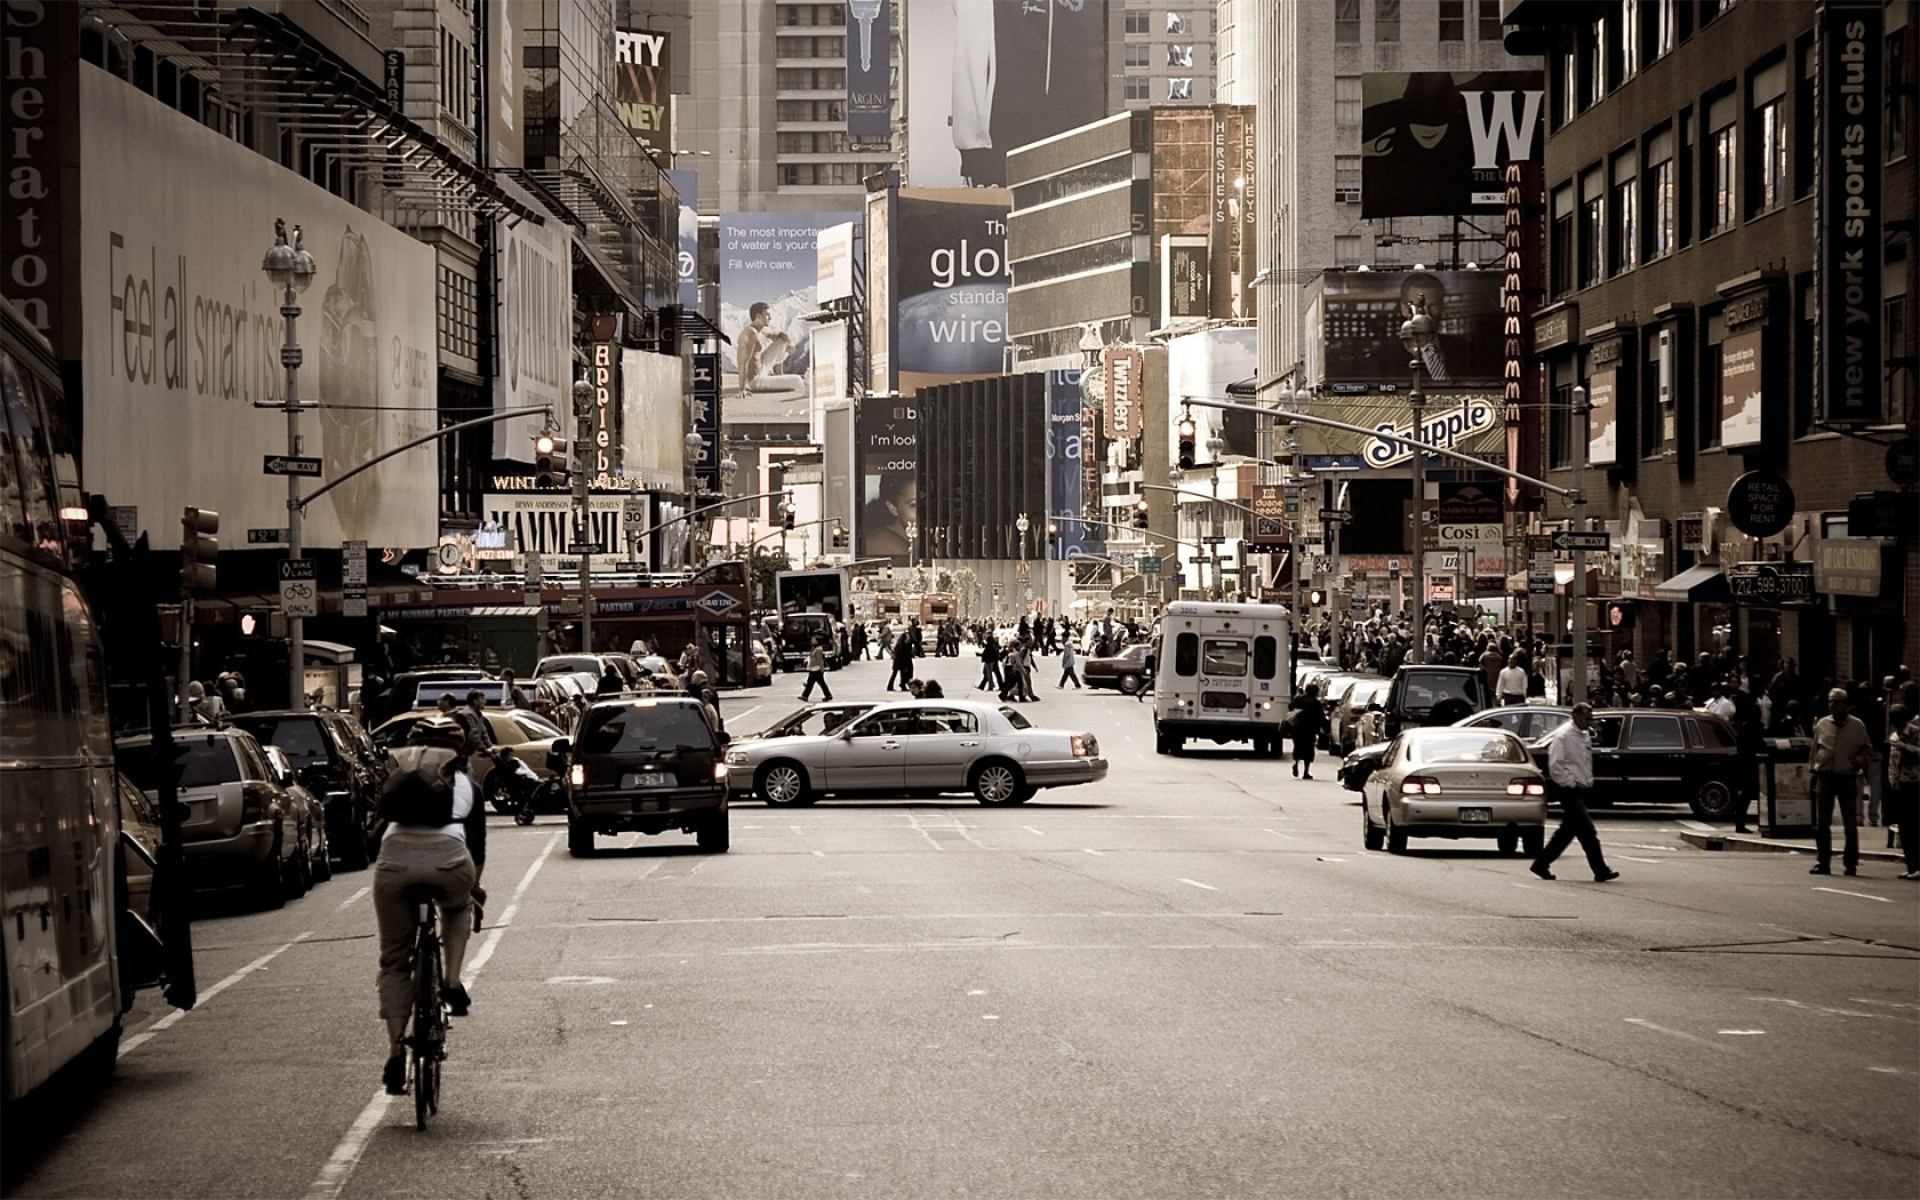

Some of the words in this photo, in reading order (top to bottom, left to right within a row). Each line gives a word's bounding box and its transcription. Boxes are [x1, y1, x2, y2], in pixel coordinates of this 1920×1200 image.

[1840, 20, 1865, 115] clubs
[1459, 90, 1545, 169] W
[5, 0, 51, 329] Sheraton
[1842, 123, 1871, 238] sports
[727, 227, 746, 237] The
[749, 228, 775, 237] most
[985, 220, 1008, 235] Th
[728, 240, 739, 250] of
[741, 241, 770, 250] water
[773, 240, 783, 250] is
[785, 242, 809, 252] your
[728, 259, 743, 269] Fill
[745, 259, 768, 269] with
[1840, 247, 1870, 324] york
[950, 290, 1008, 304] standa
[110, 231, 157, 385] Feel
[164, 254, 187, 390] all
[194, 279, 248, 402] smart
[1845, 336, 1864, 407] new
[1371, 399, 1486, 462] Snpple
[871, 434, 890, 446] I'm
[272, 461, 290, 470] ONE
[296, 462, 316, 471] WAY
[494, 476, 537, 490] WINT
[1747, 482, 1779, 492] RETAIL
[1255, 498, 1284, 507] duane
[1747, 493, 1779, 503] SPACE
[1255, 506, 1283, 515] reade
[1753, 503, 1774, 513] FOR
[625, 512, 641, 522] 30
[1750, 513, 1776, 523] RENT
[1440, 525, 1480, 541] Così
[1559, 537, 1577, 545] ONE
[1584, 537, 1602, 545] WAY
[287, 605, 309, 613] ONLY
[599, 602, 634, 612] PARTNER
